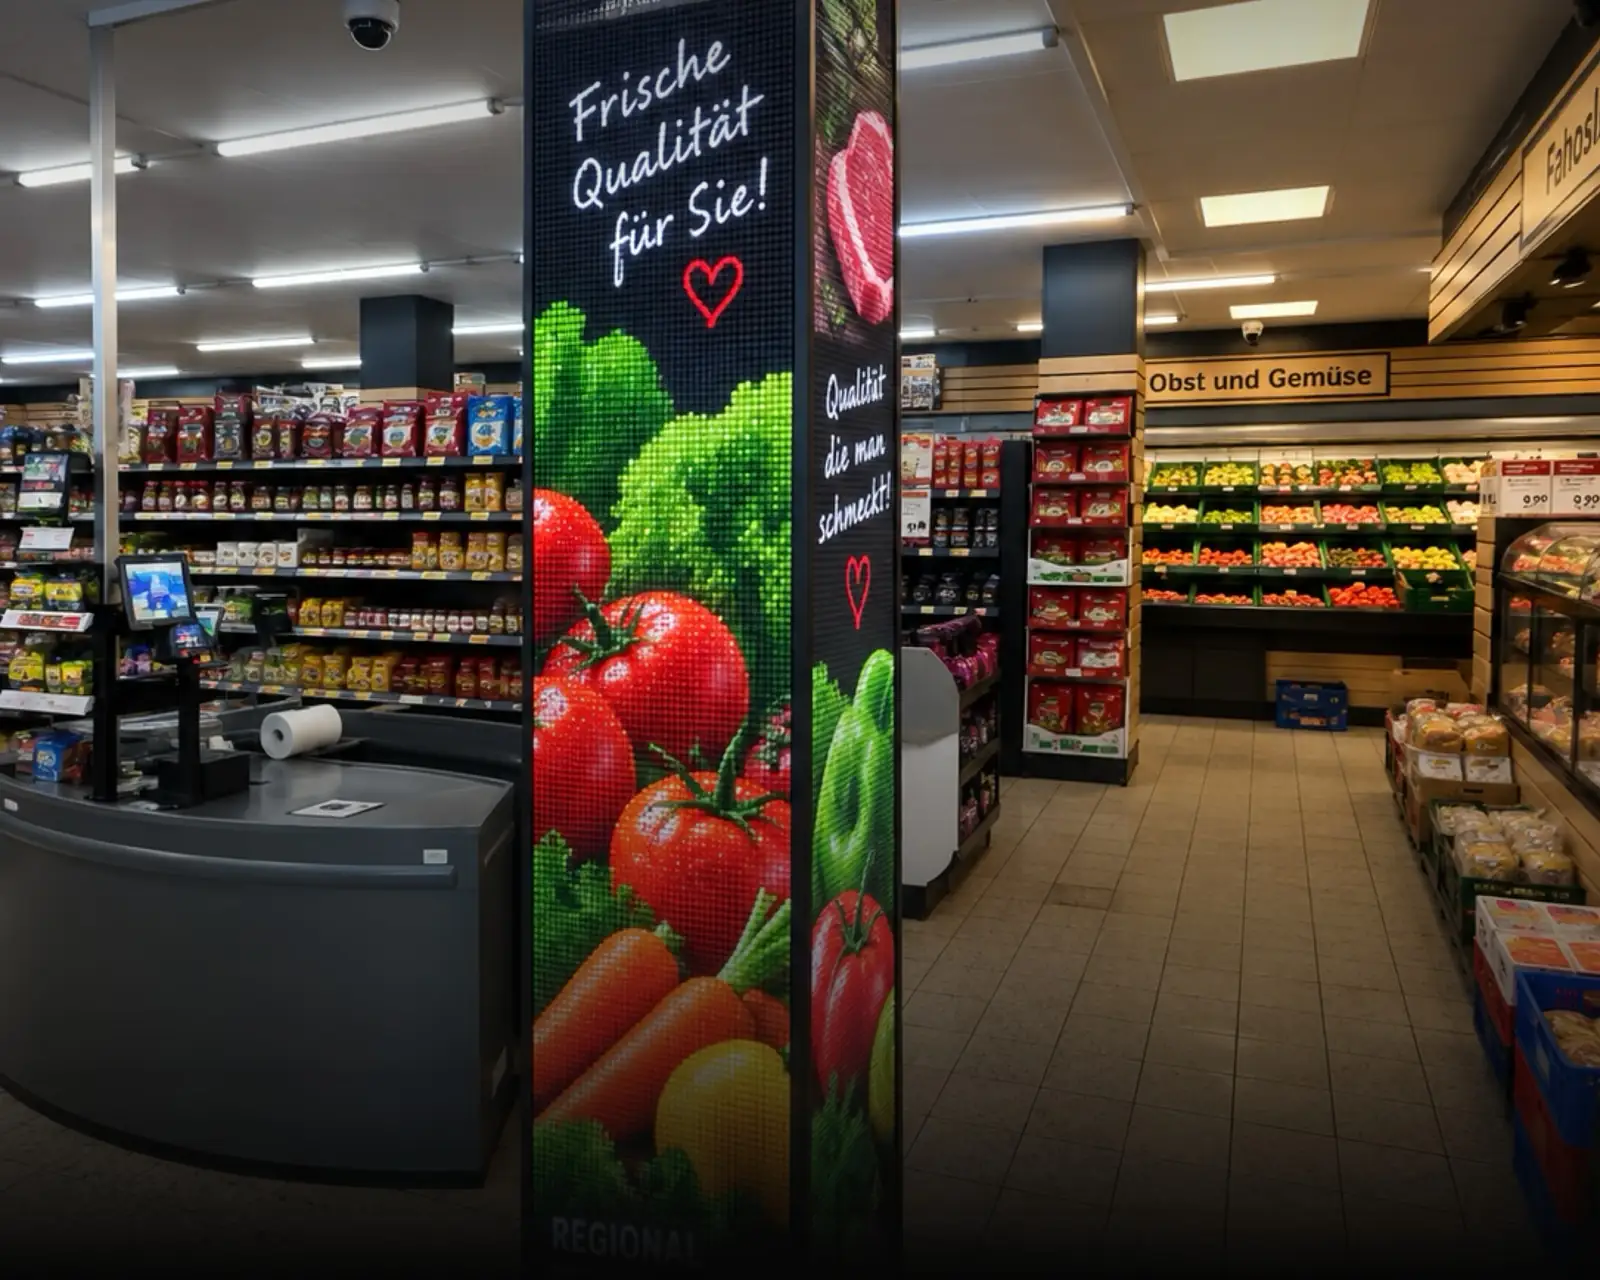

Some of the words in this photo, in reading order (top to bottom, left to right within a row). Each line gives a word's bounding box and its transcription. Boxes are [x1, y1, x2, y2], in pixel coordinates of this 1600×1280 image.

[569, 38, 731, 142] Frische
[1546, 86, 1600, 196] Fahosl
[573, 84, 764, 209] Qualität
[609, 211, 674, 288] für
[688, 156, 768, 237] Sie!
[1149, 372, 1205, 393] Obst
[1214, 369, 1260, 390] und
[1268, 366, 1372, 389] Gemüse
[817, 470, 892, 545] schmeckt!
[824, 433, 850, 480] die
[854, 432, 886, 467] man
